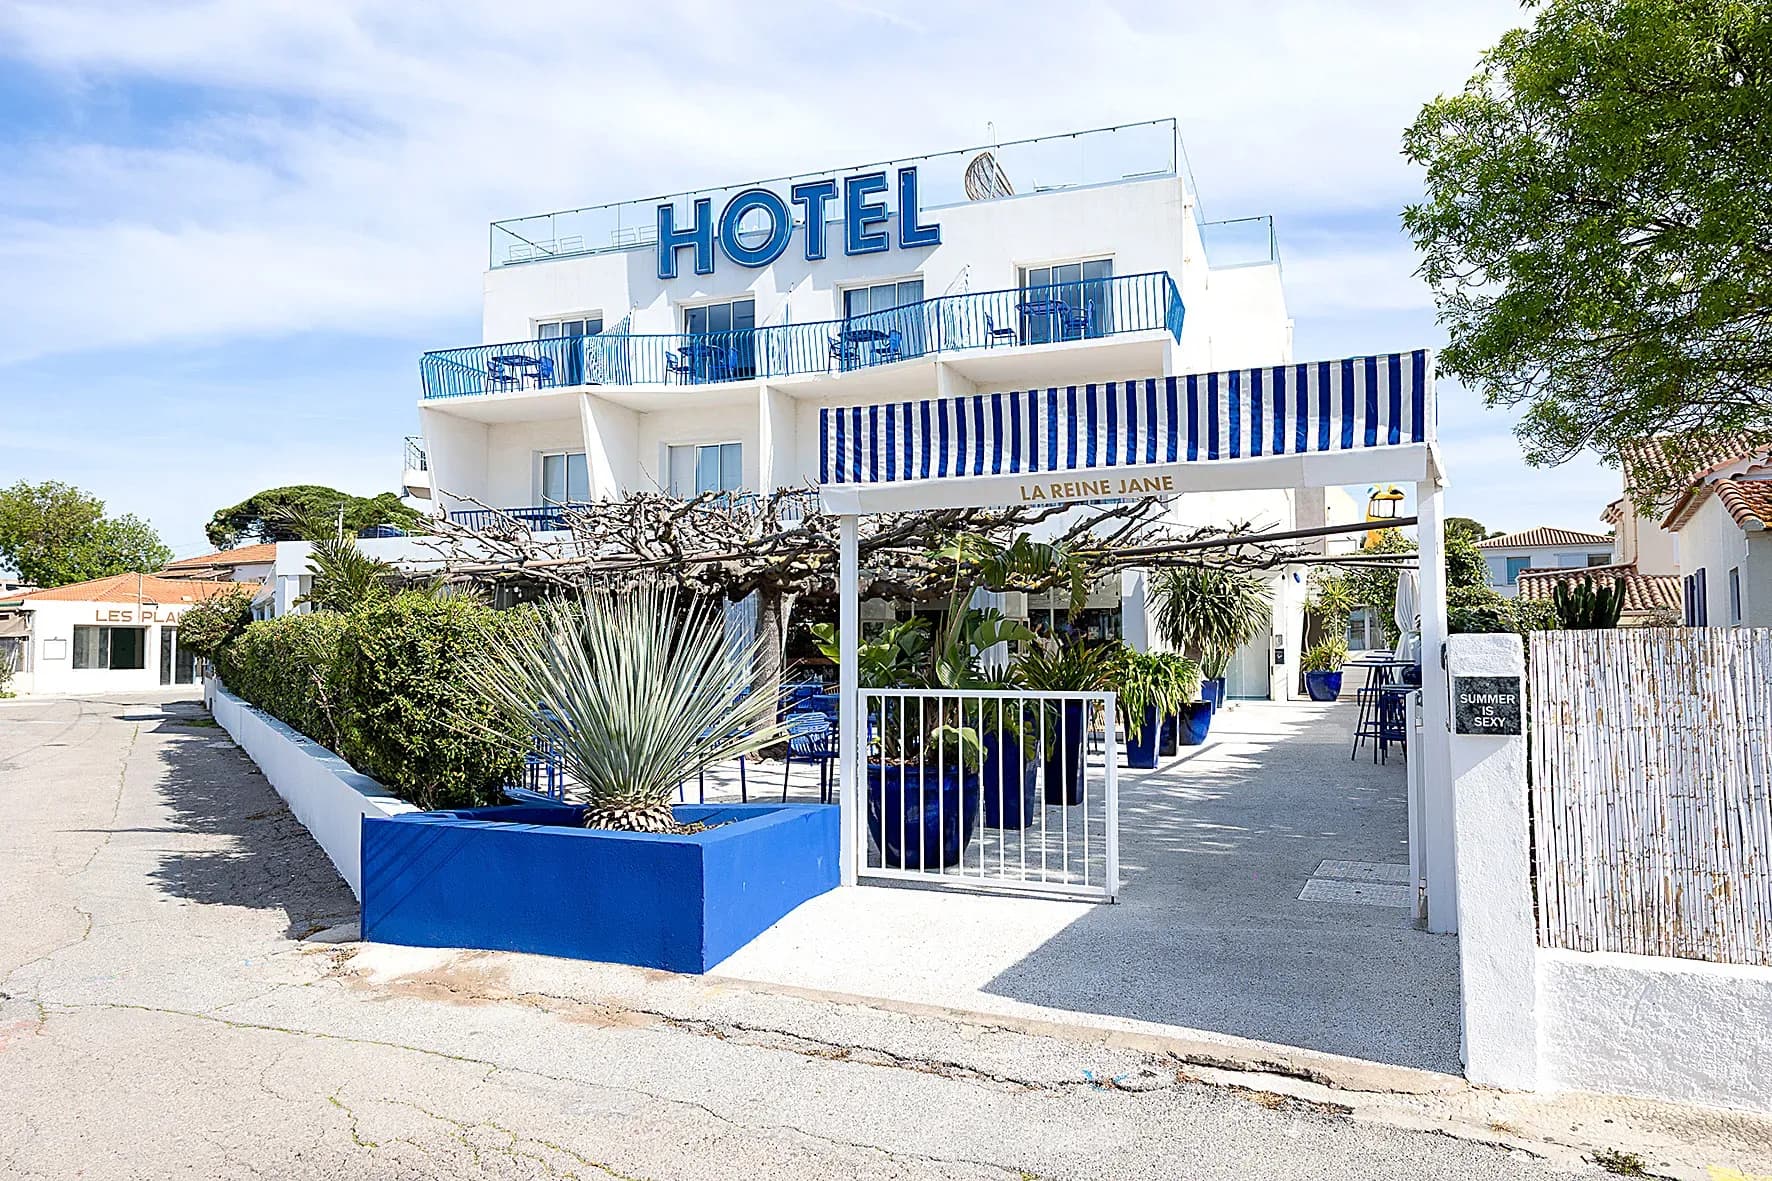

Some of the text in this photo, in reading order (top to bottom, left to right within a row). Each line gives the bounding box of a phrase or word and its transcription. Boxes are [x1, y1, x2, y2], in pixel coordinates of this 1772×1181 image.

[657, 166, 942, 279] HOTEL
[1020, 475, 1174, 501] LA REINE JANE
[95, 609, 133, 622] LES
[1460, 693, 1516, 705] SUMMER
[1482, 705, 1494, 716] IS
[1474, 716, 1506, 727] SEXY
